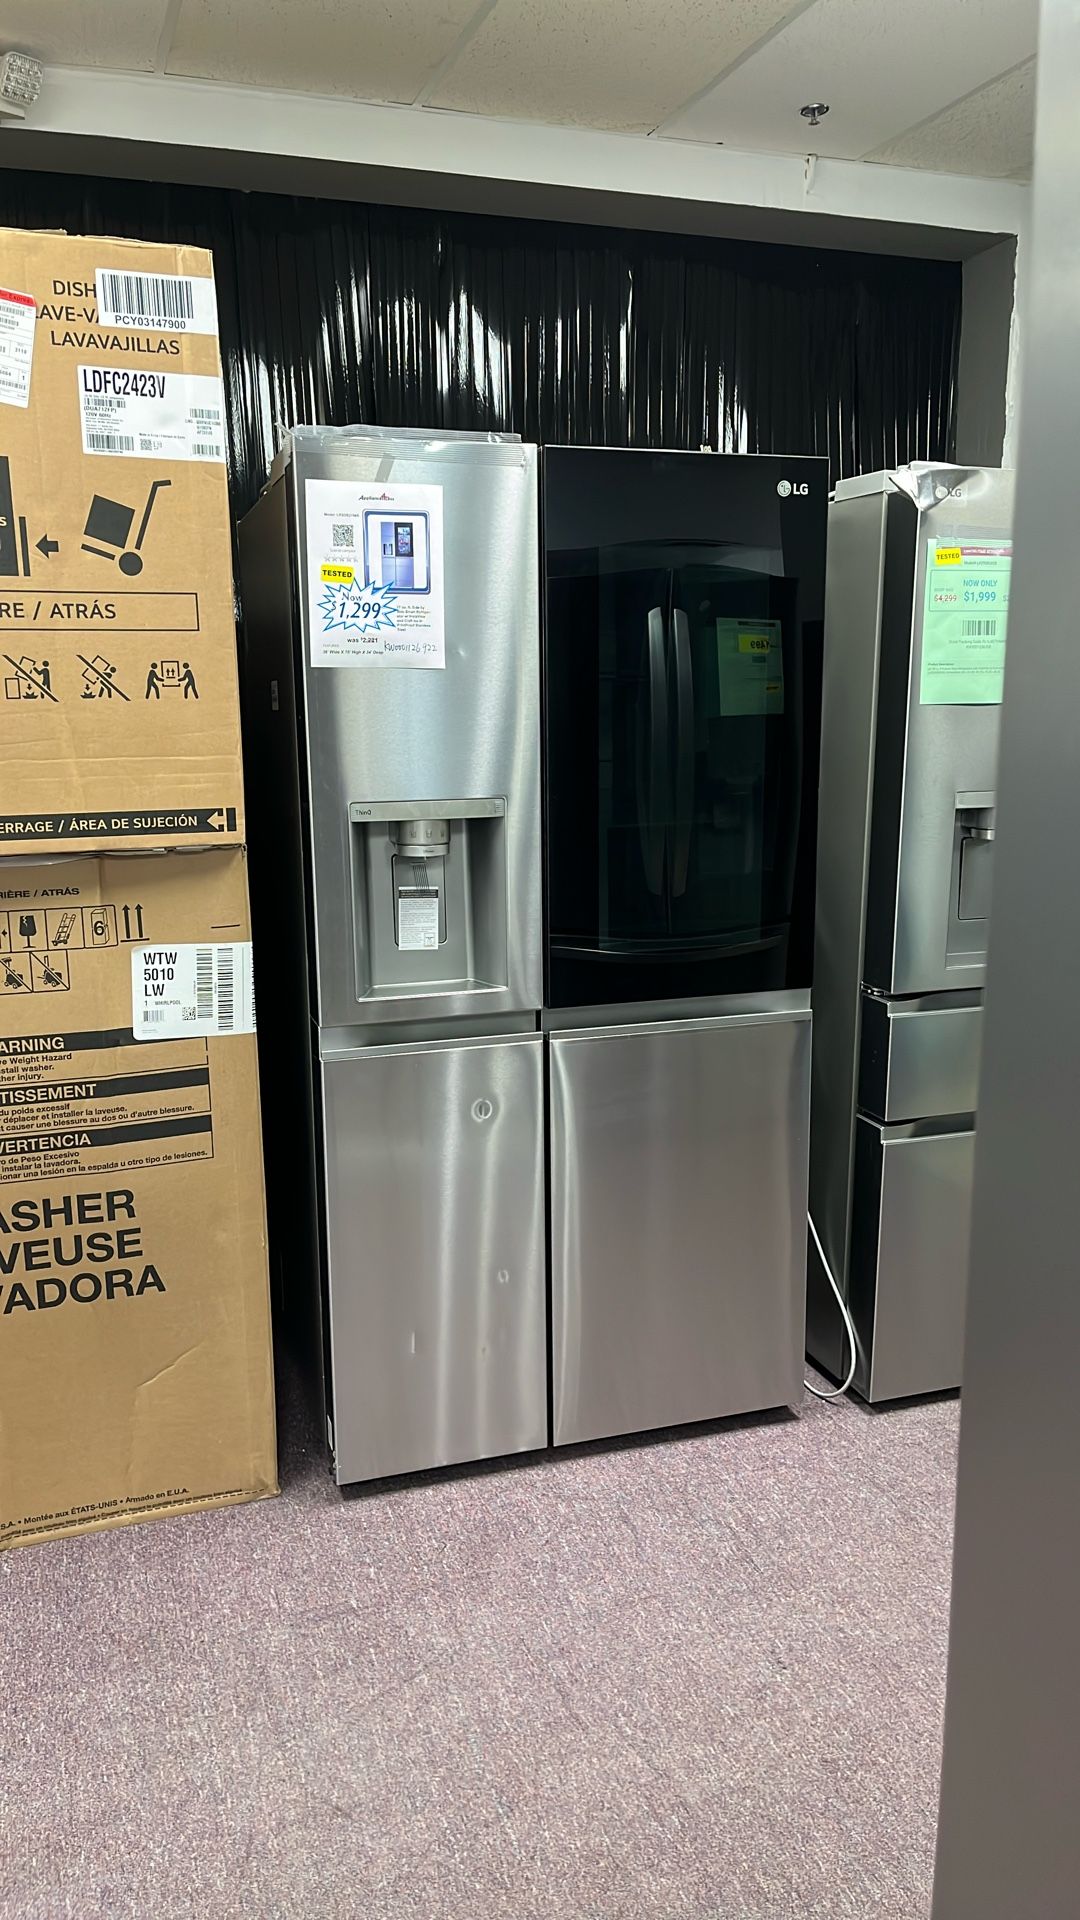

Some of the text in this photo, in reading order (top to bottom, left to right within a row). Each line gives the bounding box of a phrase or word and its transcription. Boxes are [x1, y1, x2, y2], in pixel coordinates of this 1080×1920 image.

[36, 305, 99, 323] AVE-V
[115, 315, 186, 330] PCY03147900
[51, 330, 180, 355] LAVAVAJILLAS
[83, 369, 165, 398] LDFC2423V
[793, 483, 809, 495] LG
[949, 488, 962, 498] LG
[936, 553, 960, 561] TESTED
[322, 569, 353, 578] TESTED
[963, 579, 998, 587] NOW ONLY
[341, 592, 363, 601] Now
[964, 592, 996, 604] $1,999
[50, 599, 117, 619] ATRÁS
[331, 601, 381, 619] $1,299
[69, 817, 107, 831] ÁREA
[111, 818, 130, 830] DE
[134, 814, 198, 829] SUJECIÓN
[41, 886, 80, 897] ATRÁS
[143, 952, 178, 965] WTW
[143, 968, 174, 981] 5010
[144, 984, 165, 997] LW
[9, 1056, 40, 1065] Weight
[41, 1053, 72, 1062] Hazard
[21, 1064, 54, 1073] washer.
[17, 1073, 45, 1082] injury.
[3, 1113, 39, 1124] déplacer
[51, 1110, 84, 1119] installer
[95, 1106, 128, 1115] laveuse.
[12, 1107, 34, 1117] poids
[36, 1103, 70, 1113] excessif
[6, 1123, 34, 1132] causer
[53, 1117, 87, 1127] blessure
[102, 1114, 117, 1122] dos
[130, 1109, 158, 1119] d'autre
[159, 1104, 195, 1115] blessure.
[2, 1158, 81, 1172] instalar la lavadora.
[8, 1157, 19, 1165] de
[21, 1154, 41, 1163] Peso
[44, 1151, 80, 1160] Excesivo
[40, 1168, 65, 1177] lesión
[78, 1163, 86, 1171] la
[88, 1161, 119, 1172] espalda
[128, 1158, 144, 1166] otro
[145, 1155, 161, 1165] tipo
[174, 1150, 208, 1160] lesiones.
[0, 1264, 166, 1315] ADORA
[24, 1513, 54, 1524] Montée
[55, 1510, 69, 1518] aux
[70, 1499, 118, 1515] ÉTATS-UNIS
[125, 1493, 155, 1503] Armado
